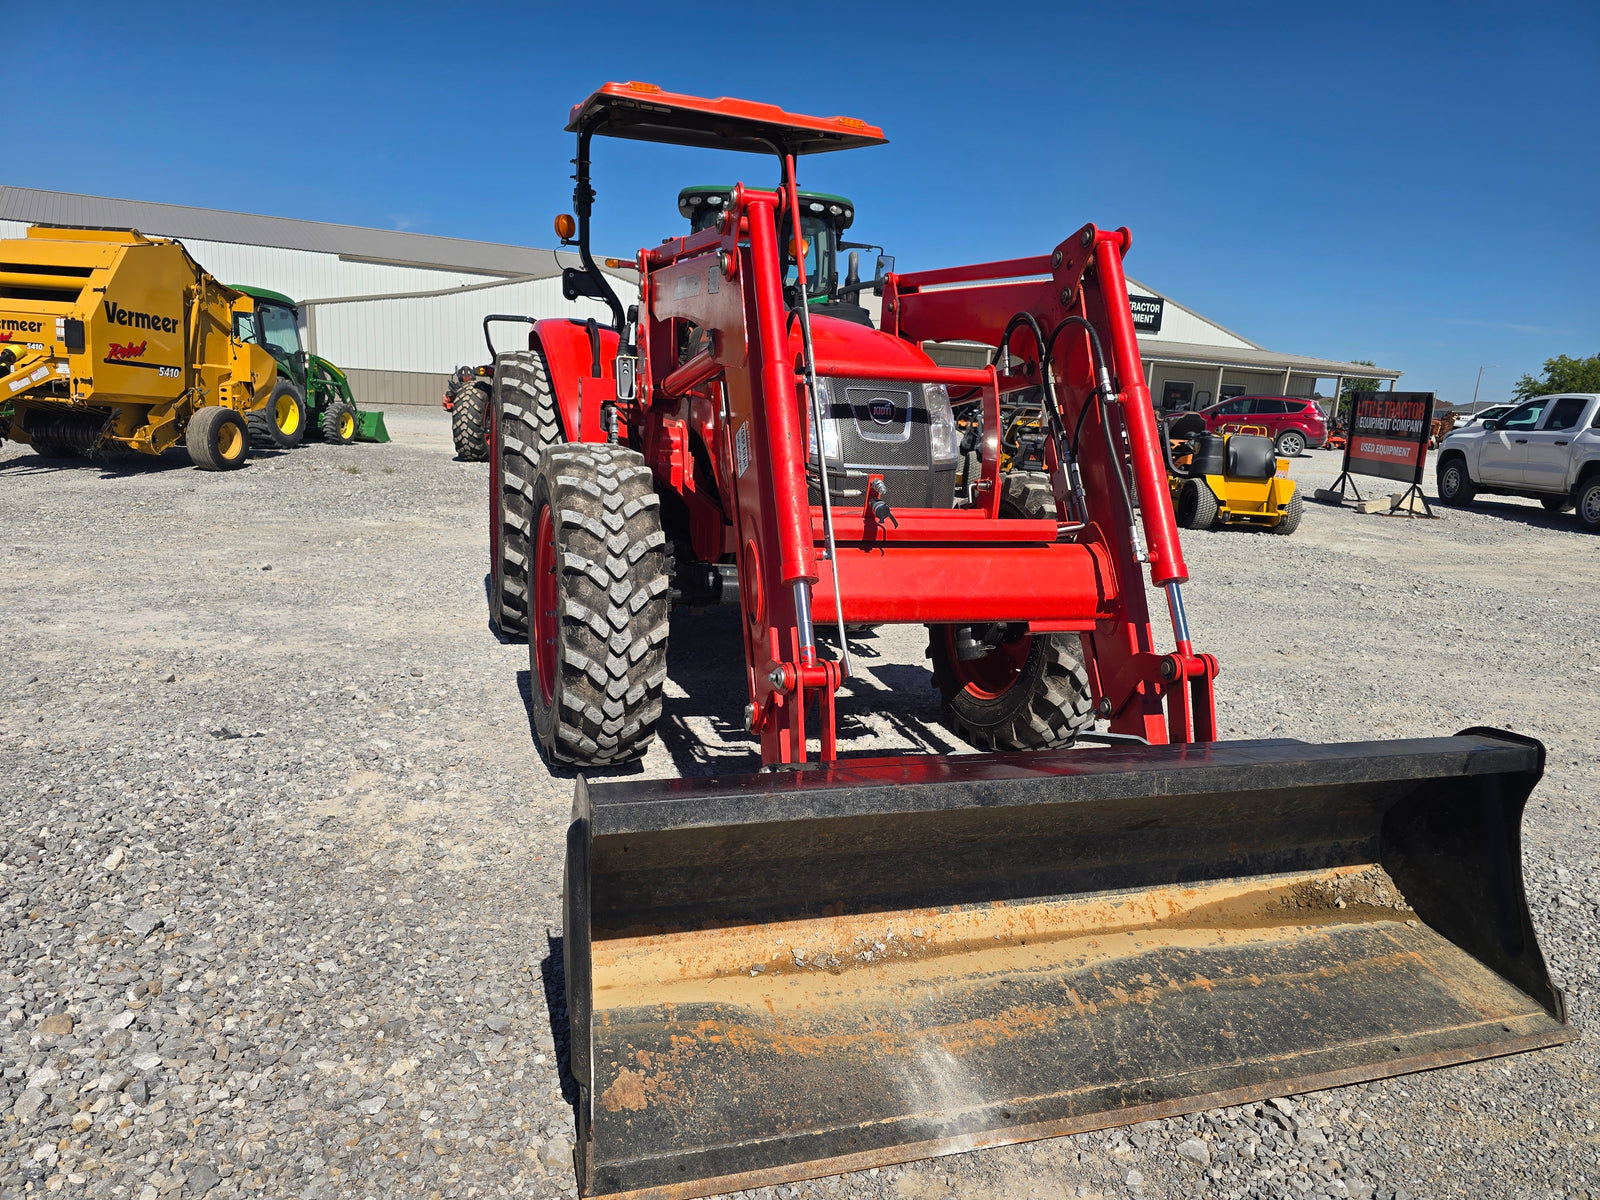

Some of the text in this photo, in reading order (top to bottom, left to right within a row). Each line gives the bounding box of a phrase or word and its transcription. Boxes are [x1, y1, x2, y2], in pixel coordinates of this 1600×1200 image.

[104, 300, 178, 333] Vermeer
[0, 319, 42, 332] rmeer
[107, 340, 147, 361] Rebel
[158, 366, 180, 378] 5410
[1357, 401, 1426, 419] LITTLE TRACTOR
[1360, 417, 1423, 432] EQUIPMENT COMPANY
[1360, 442, 1411, 457] USED EQUIPMENT
